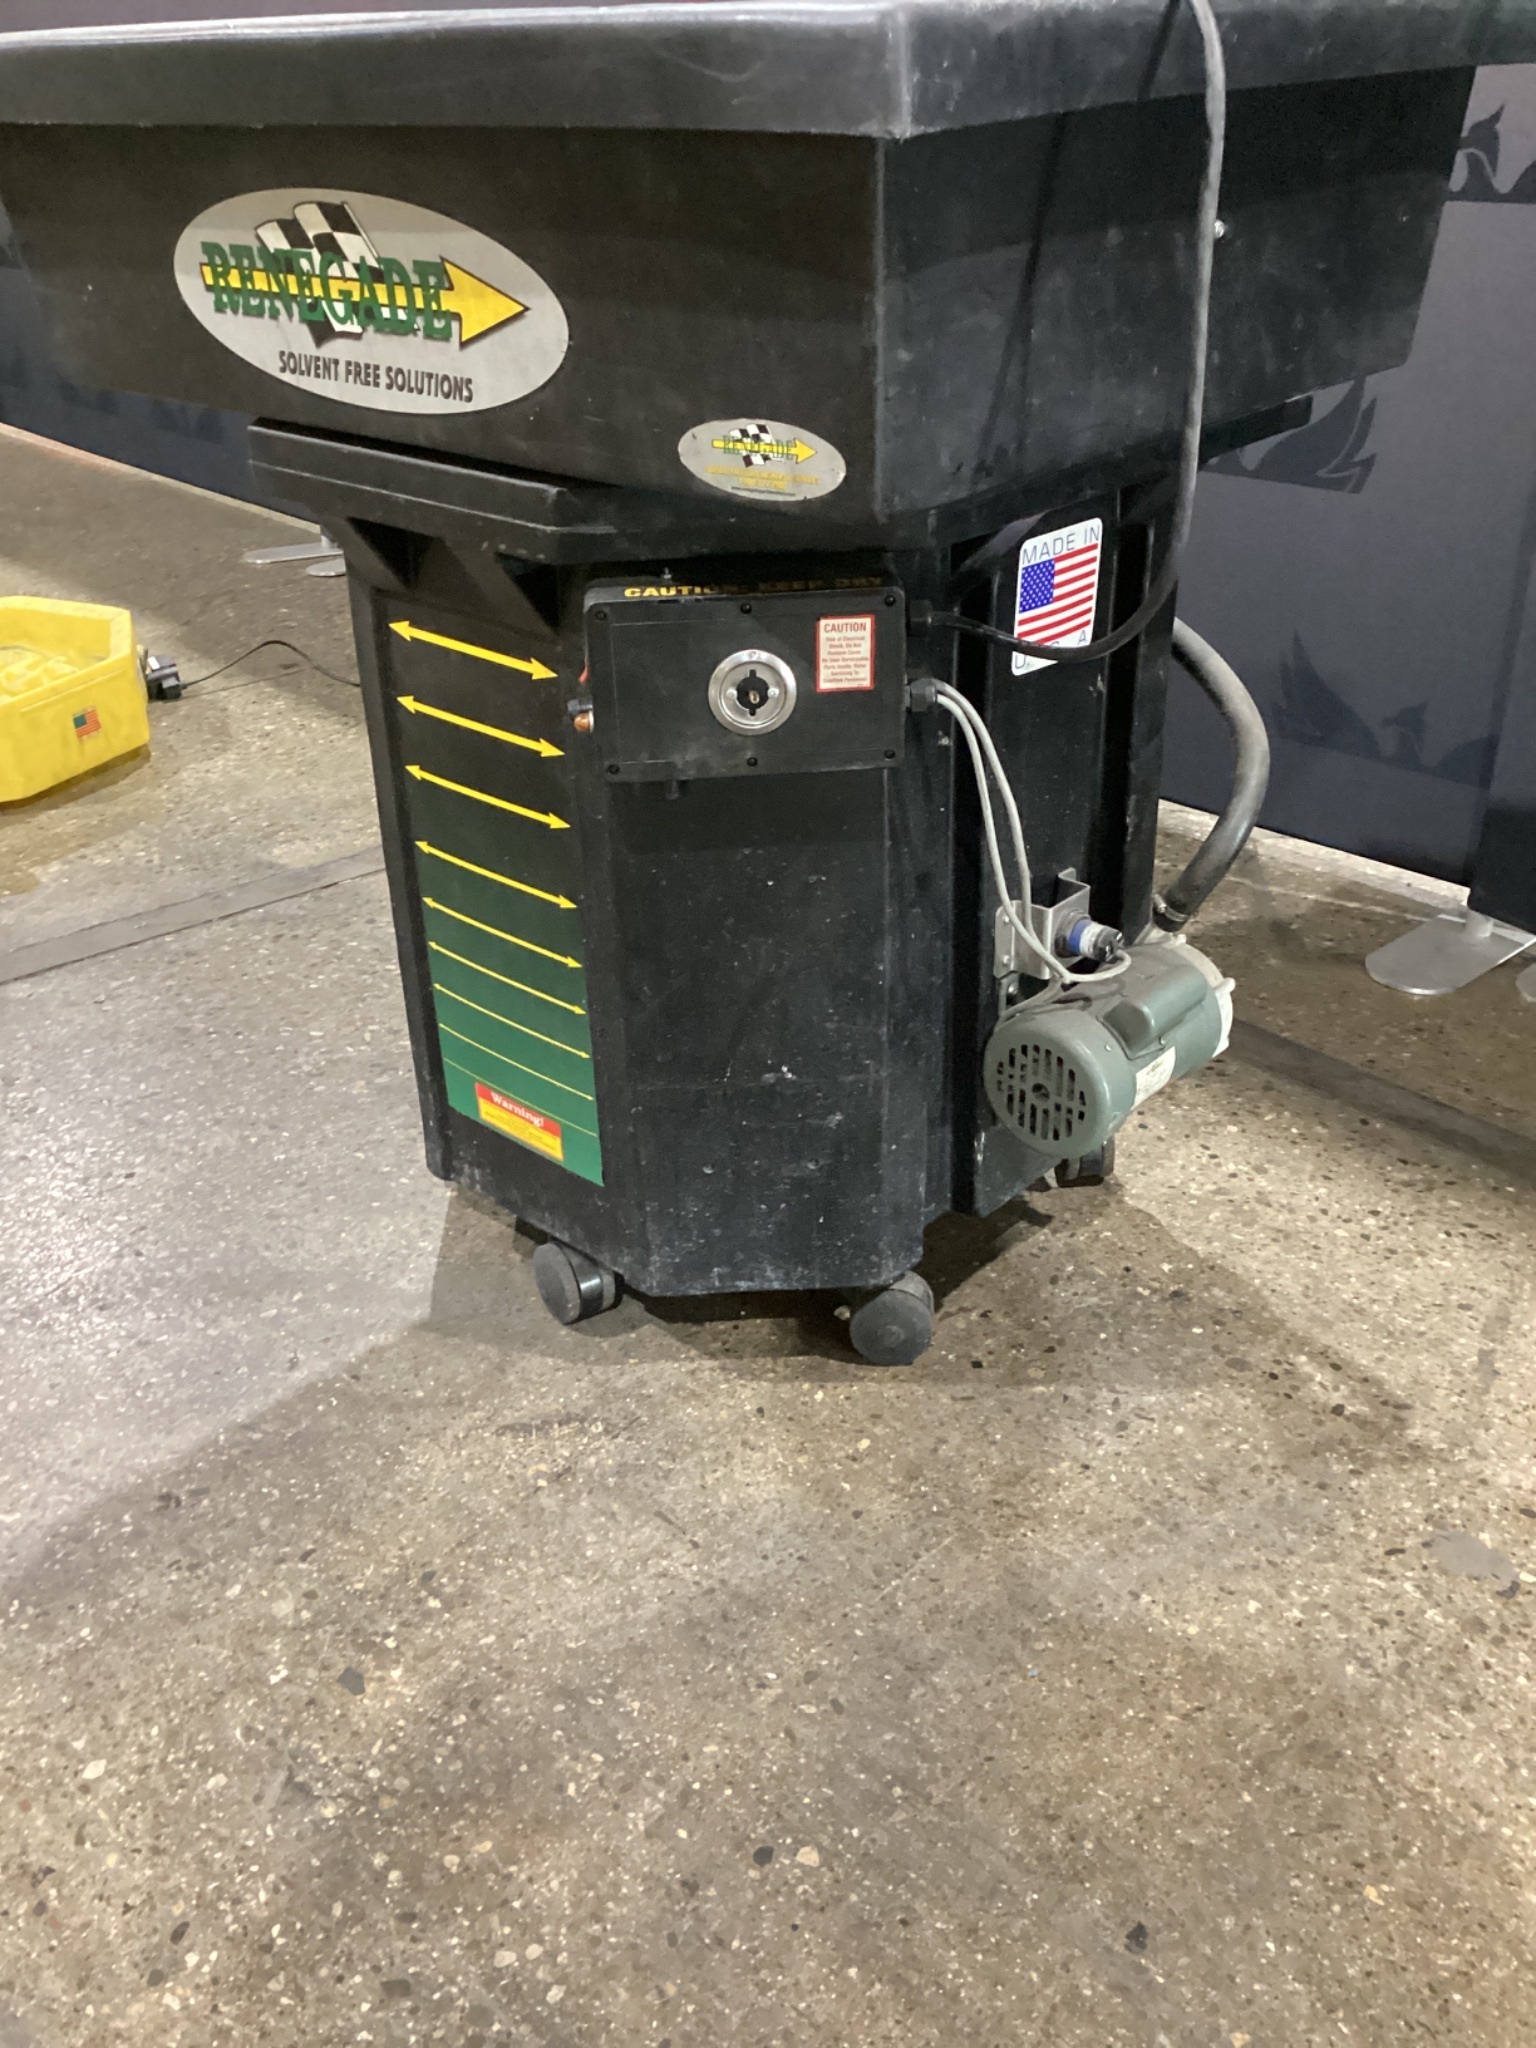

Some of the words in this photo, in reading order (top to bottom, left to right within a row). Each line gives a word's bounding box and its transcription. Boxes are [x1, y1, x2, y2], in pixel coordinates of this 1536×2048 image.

[201, 241, 452, 342] RENEGADE
[278, 350, 339, 382] SOLVENT
[344, 359, 381, 389] FREE
[385, 365, 474, 404] SOLUTIONS
[1022, 532, 1076, 564] MADE
[1084, 525, 1099, 545] IN
[823, 621, 867, 634] CAUTION
[491, 1091, 544, 1128] Warning!
